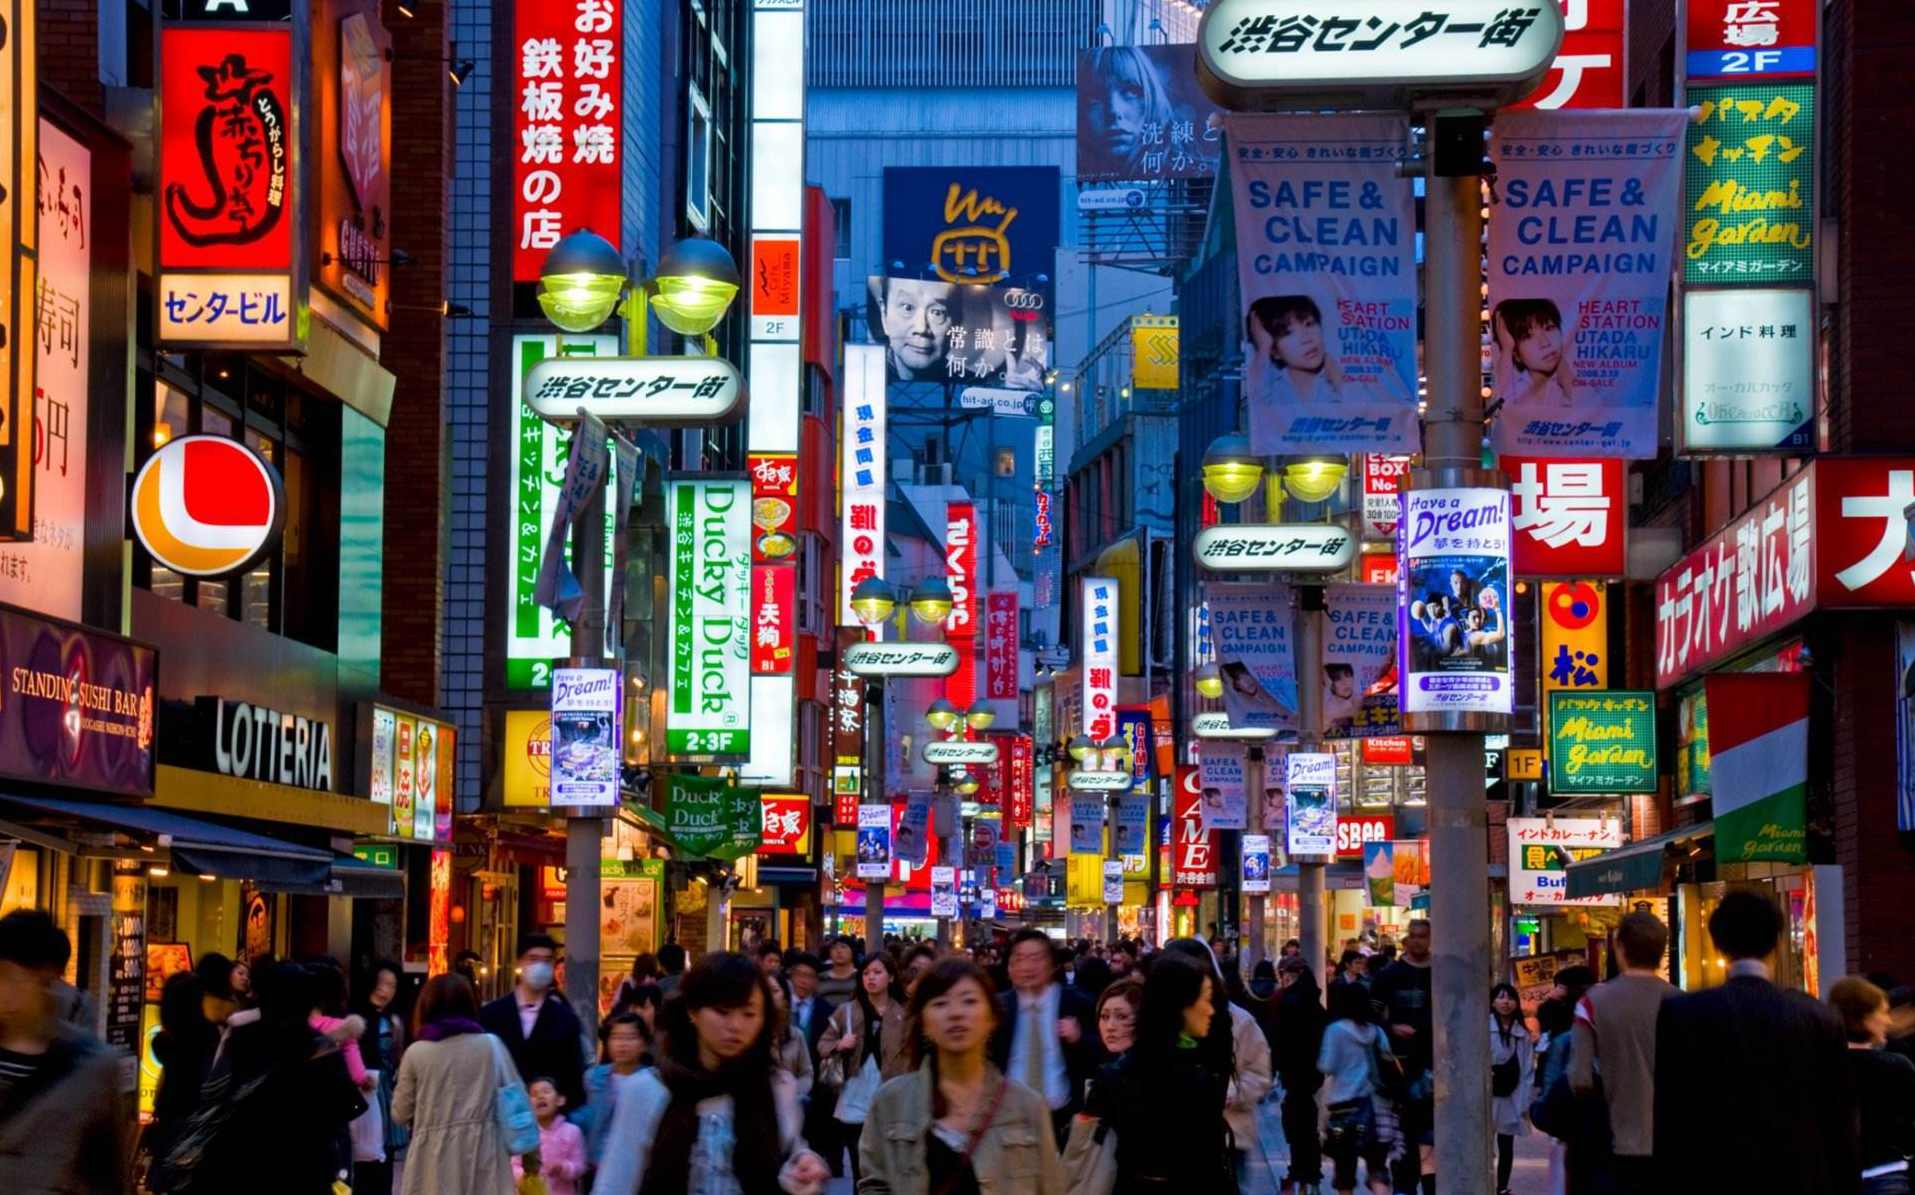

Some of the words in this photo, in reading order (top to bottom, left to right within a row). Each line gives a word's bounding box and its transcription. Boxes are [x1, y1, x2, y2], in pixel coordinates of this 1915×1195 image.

[1219, 8, 1541, 54] 渋谷センター街
[1721, 51, 1782, 73] 2F
[573, 0, 614, 165] お好み焼
[521, 38, 563, 249] 鉄板焼の店
[1693, 134, 1805, 165] キッチン
[1249, 180, 1350, 210] SAFE
[1358, 181, 1385, 209] &
[1505, 178, 1613, 208] SAFE
[1619, 177, 1646, 206] &
[1697, 179, 1803, 214] Miami
[1265, 216, 1398, 246] CLEAN
[1517, 214, 1658, 245] CLEAN
[1254, 253, 1400, 276] CAMPAIGN
[1502, 253, 1657, 276] CAMPAIGN
[1697, 259, 1803, 273] マイアミガーデン
[165, 291, 287, 325] センタービル
[1578, 300, 1641, 314] HEART
[765, 321, 785, 334] 2F
[1580, 314, 1660, 329] STATION
[1700, 324, 1799, 340] インド料理
[946, 326, 1045, 353] 常識とは
[1575, 330, 1637, 345] UTADA
[1577, 345, 1650, 360] HIKARU
[946, 355, 1006, 379] 何か。
[535, 376, 729, 400] 渋谷センター街
[962, 395, 1023, 409] hit-ad.co.jp
[1369, 463, 1405, 476] BOX
[1410, 498, 1446, 512] Have
[1450, 499, 1460, 509] a
[1512, 462, 1611, 550] 場
[1410, 496, 1506, 549] Dream!
[696, 484, 735, 606] Ducky
[1203, 537, 1347, 557] 渋谷センター街
[1658, 476, 1811, 677] カラオケ歌広場
[675, 512, 694, 690] 渋谷キッチン&カフェ
[757, 603, 780, 648] 天狗
[1214, 610, 1260, 624] SAFE
[1265, 610, 1277, 623] &
[1332, 610, 1380, 624] SAFE
[1222, 626, 1285, 640] CLEAN
[1336, 626, 1398, 641] CLEAN
[850, 650, 953, 666] 渋谷センター街
[1221, 643, 1287, 654] CAMPAIGN
[700, 615, 734, 715] Duck
[1550, 645, 1600, 687] 松
[12, 667, 80, 705] STANDING
[555, 672, 613, 705] Dream!
[79, 682, 112, 713] SUSHI
[114, 690, 138, 717] BAR
[1557, 717, 1633, 742] Miami
[216, 700, 332, 792] LOTTERIA
[1207, 767, 1242, 776] CLEAN
[1514, 756, 1537, 774] 1F
[1567, 775, 1645, 786] マイアミガーデン
[674, 809, 721, 827] Duck
[1759, 823, 1806, 840] Miami
